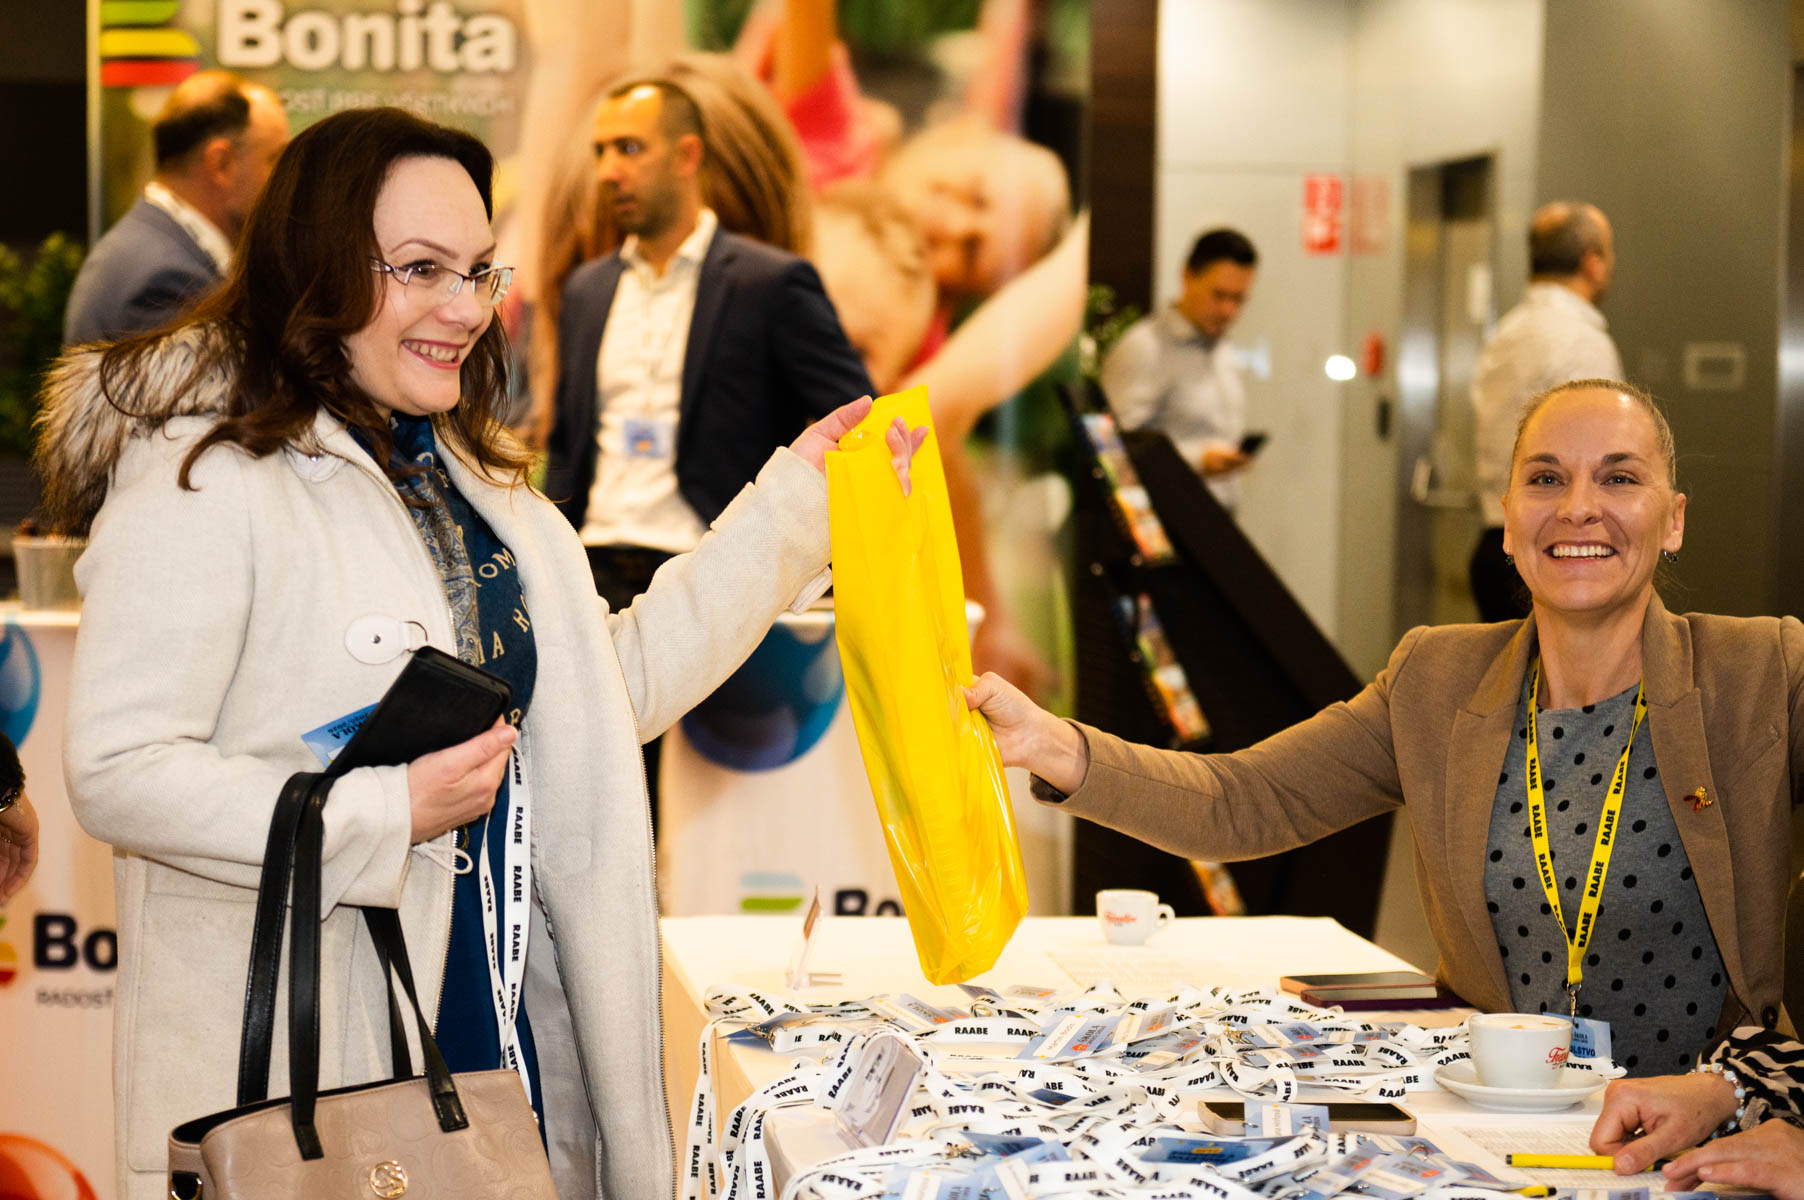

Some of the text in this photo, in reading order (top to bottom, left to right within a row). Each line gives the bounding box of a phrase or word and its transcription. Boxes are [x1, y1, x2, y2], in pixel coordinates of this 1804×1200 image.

[216, 0, 516, 71] Bonita
[1529, 758, 1538, 791] RAABE
[1613, 761, 1626, 795] RAABE
[513, 806, 524, 845] RAABE
[1532, 804, 1542, 838] RAABE
[1601, 809, 1616, 846] RAABE
[513, 865, 522, 903] RAABE
[1538, 853, 1553, 889] RAABE
[1588, 861, 1604, 898] RAABE
[511, 924, 521, 962] RAABE
[1578, 912, 1592, 947] RAABE
[955, 1027, 988, 1035] RAABE
[1378, 1047, 1408, 1065] RAABE
[1045, 1082, 1063, 1090] ABE
[696, 1093, 705, 1126] RAABE
[730, 1106, 746, 1138] RAABE
[691, 1145, 700, 1178] RAABE
[708, 1162, 716, 1195] RAABE
[754, 1161, 765, 1199] RAABE
